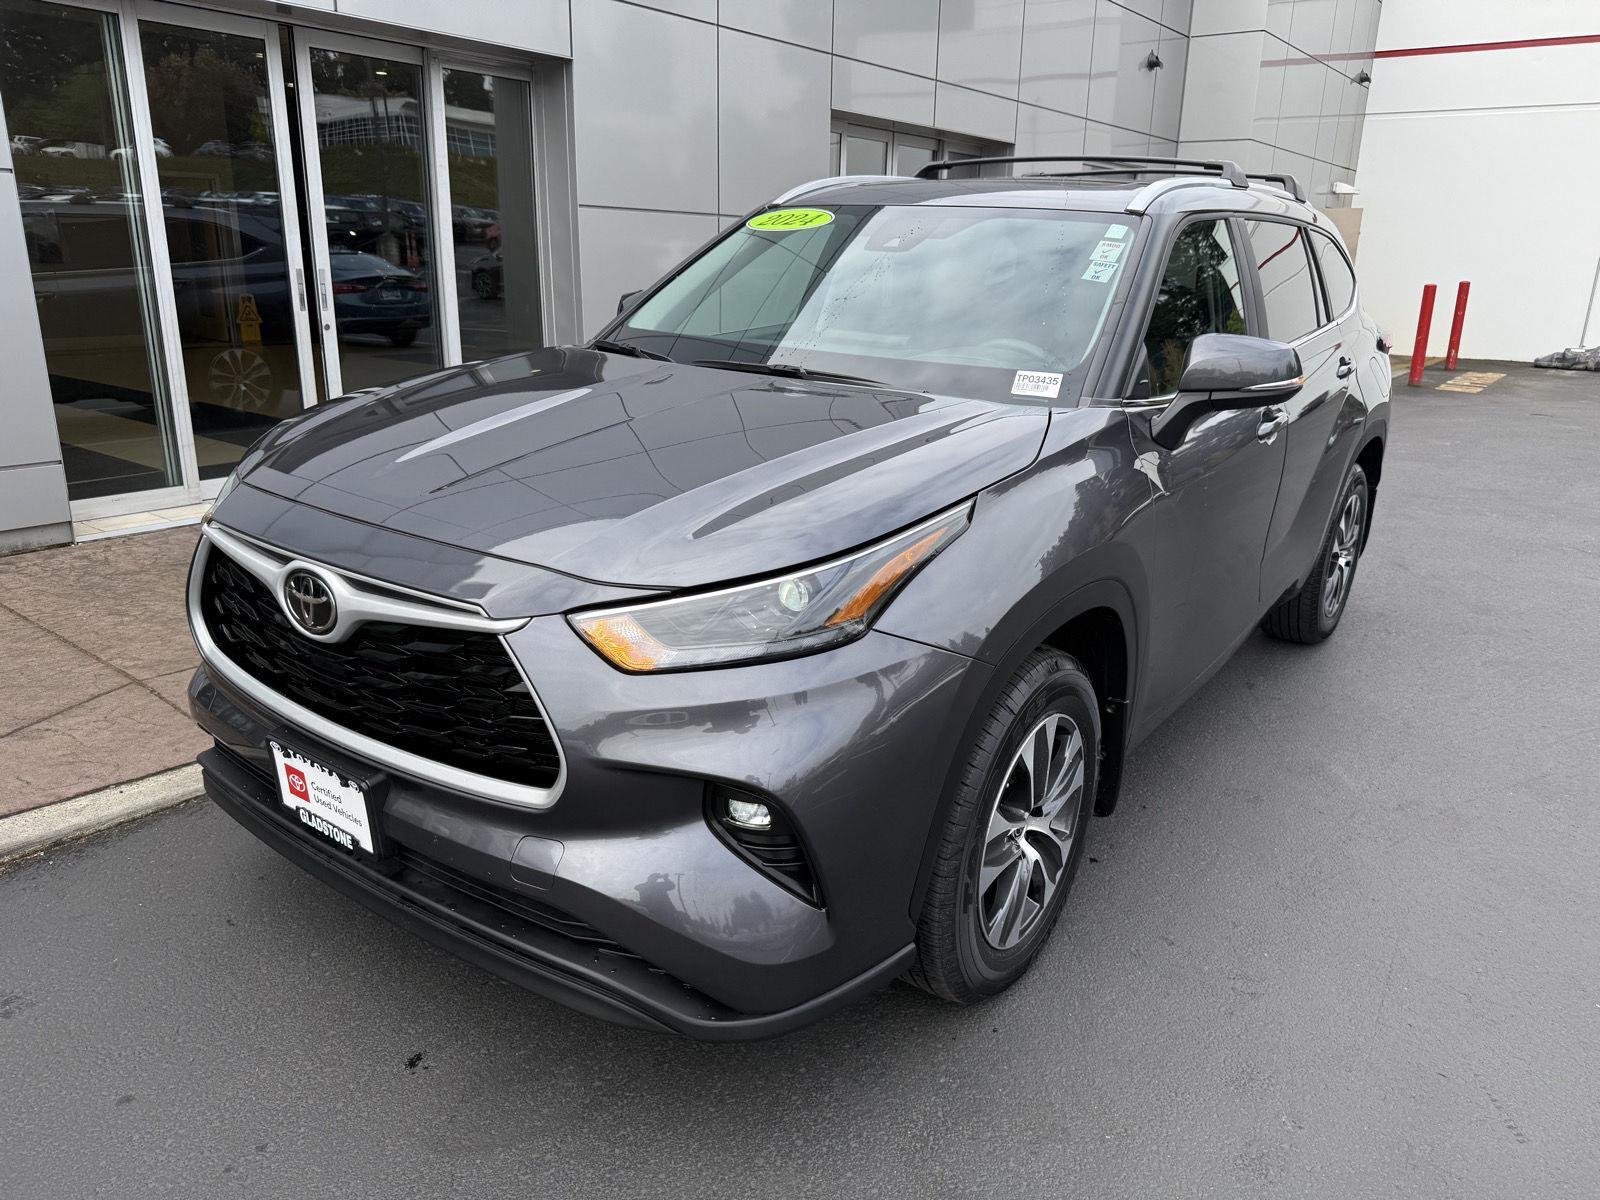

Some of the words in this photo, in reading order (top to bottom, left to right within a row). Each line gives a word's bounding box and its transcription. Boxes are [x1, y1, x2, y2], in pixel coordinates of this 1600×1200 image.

[756, 213, 825, 226] 2024
[1017, 374, 1060, 385] TP03435
[311, 782, 343, 805] Certified
[313, 794, 332, 810] Used
[332, 804, 363, 827] Vehicles
[299, 808, 354, 850] GLADSTONE
